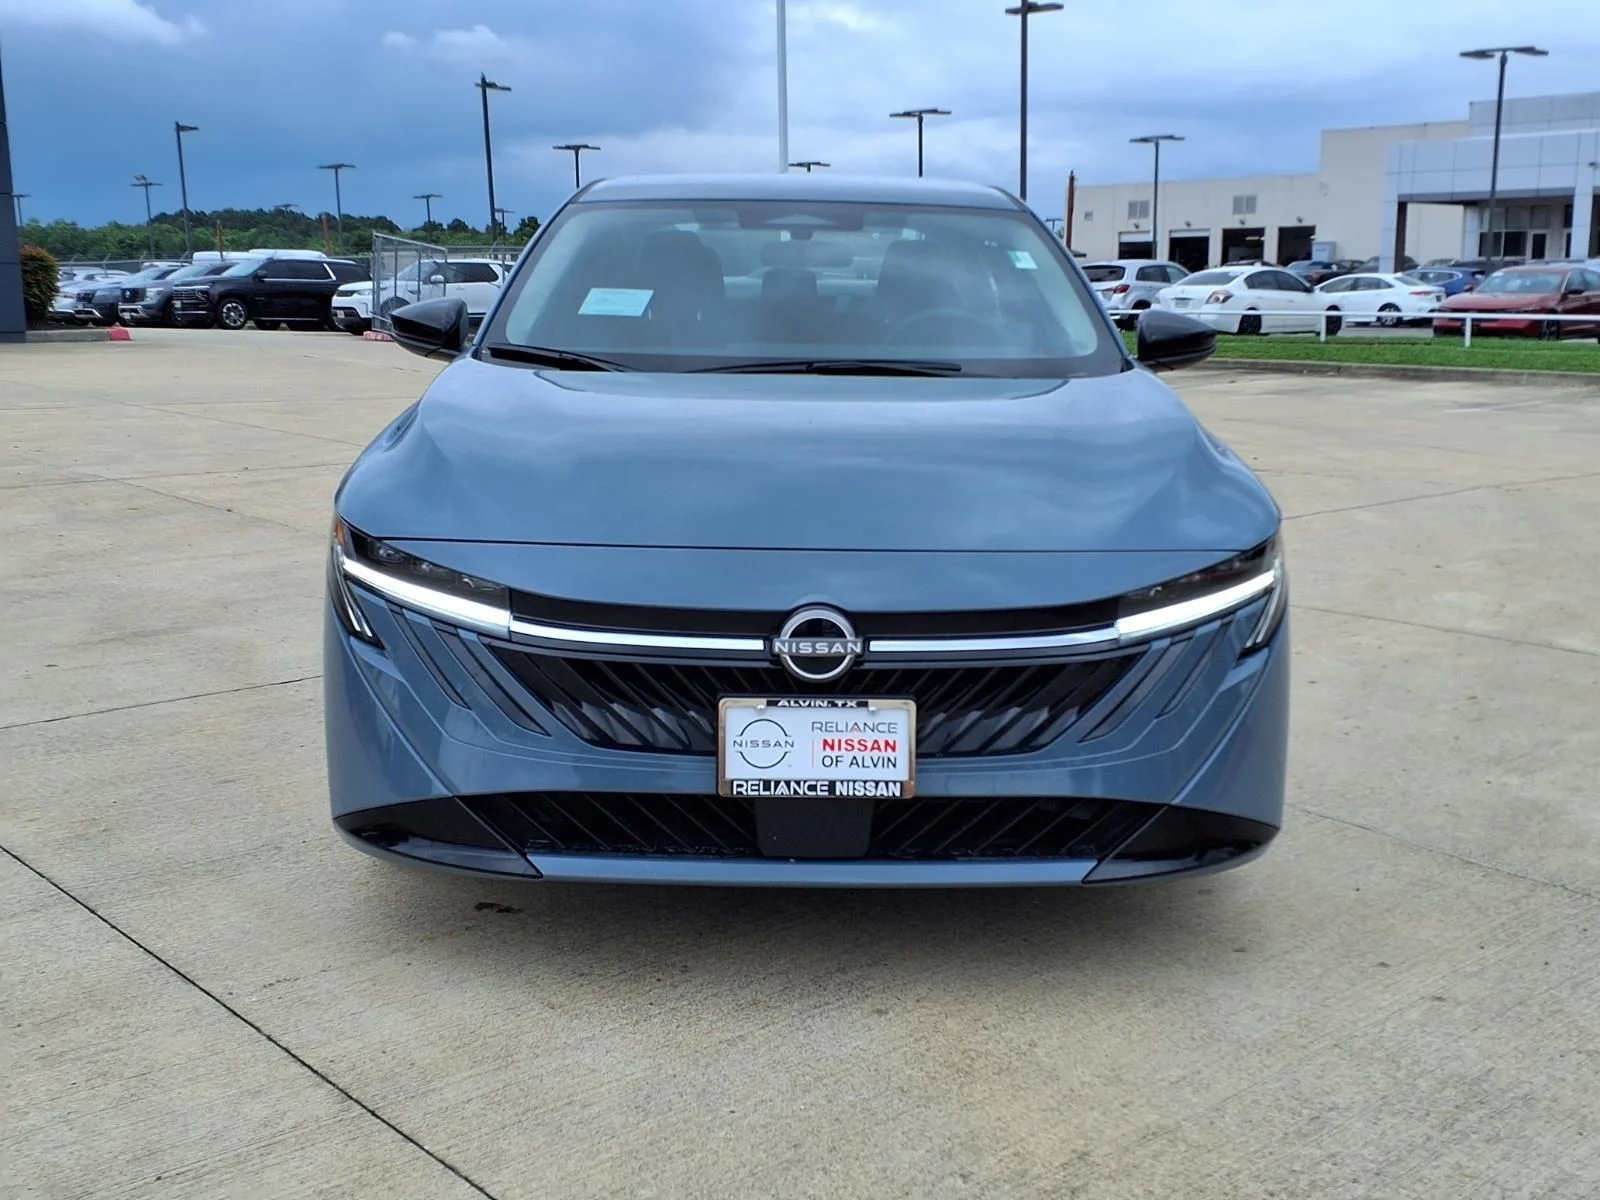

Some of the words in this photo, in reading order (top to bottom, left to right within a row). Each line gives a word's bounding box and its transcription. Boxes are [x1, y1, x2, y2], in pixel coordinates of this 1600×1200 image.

[774, 642, 861, 654] NISSAN
[811, 721, 898, 733] RELIANCE
[733, 739, 794, 748] NISSAN
[822, 738, 896, 752] NISSAN
[822, 755, 844, 768] OF
[849, 756, 897, 769] ALVIN
[733, 781, 829, 795] RELIANCE
[836, 781, 900, 796] NISSAN
